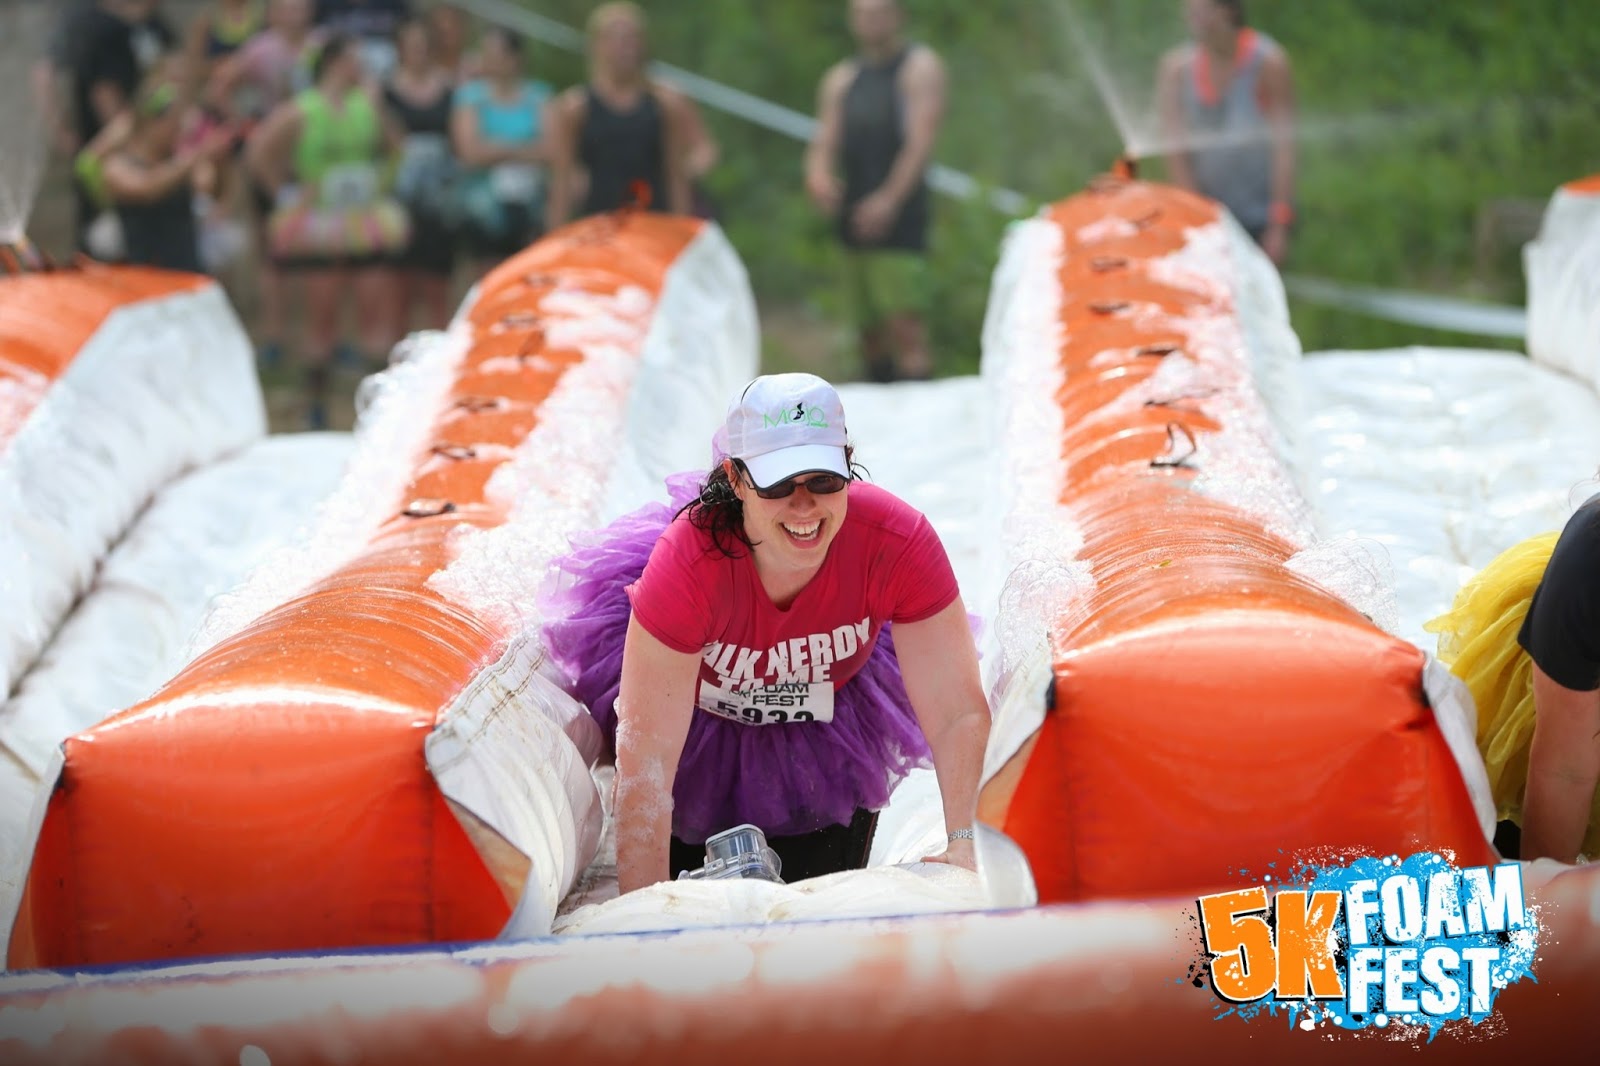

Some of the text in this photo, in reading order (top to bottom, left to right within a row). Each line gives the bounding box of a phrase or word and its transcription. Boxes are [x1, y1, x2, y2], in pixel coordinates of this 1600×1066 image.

[702, 616, 870, 680] ALK NERDY
[753, 695, 809, 706] FEST
